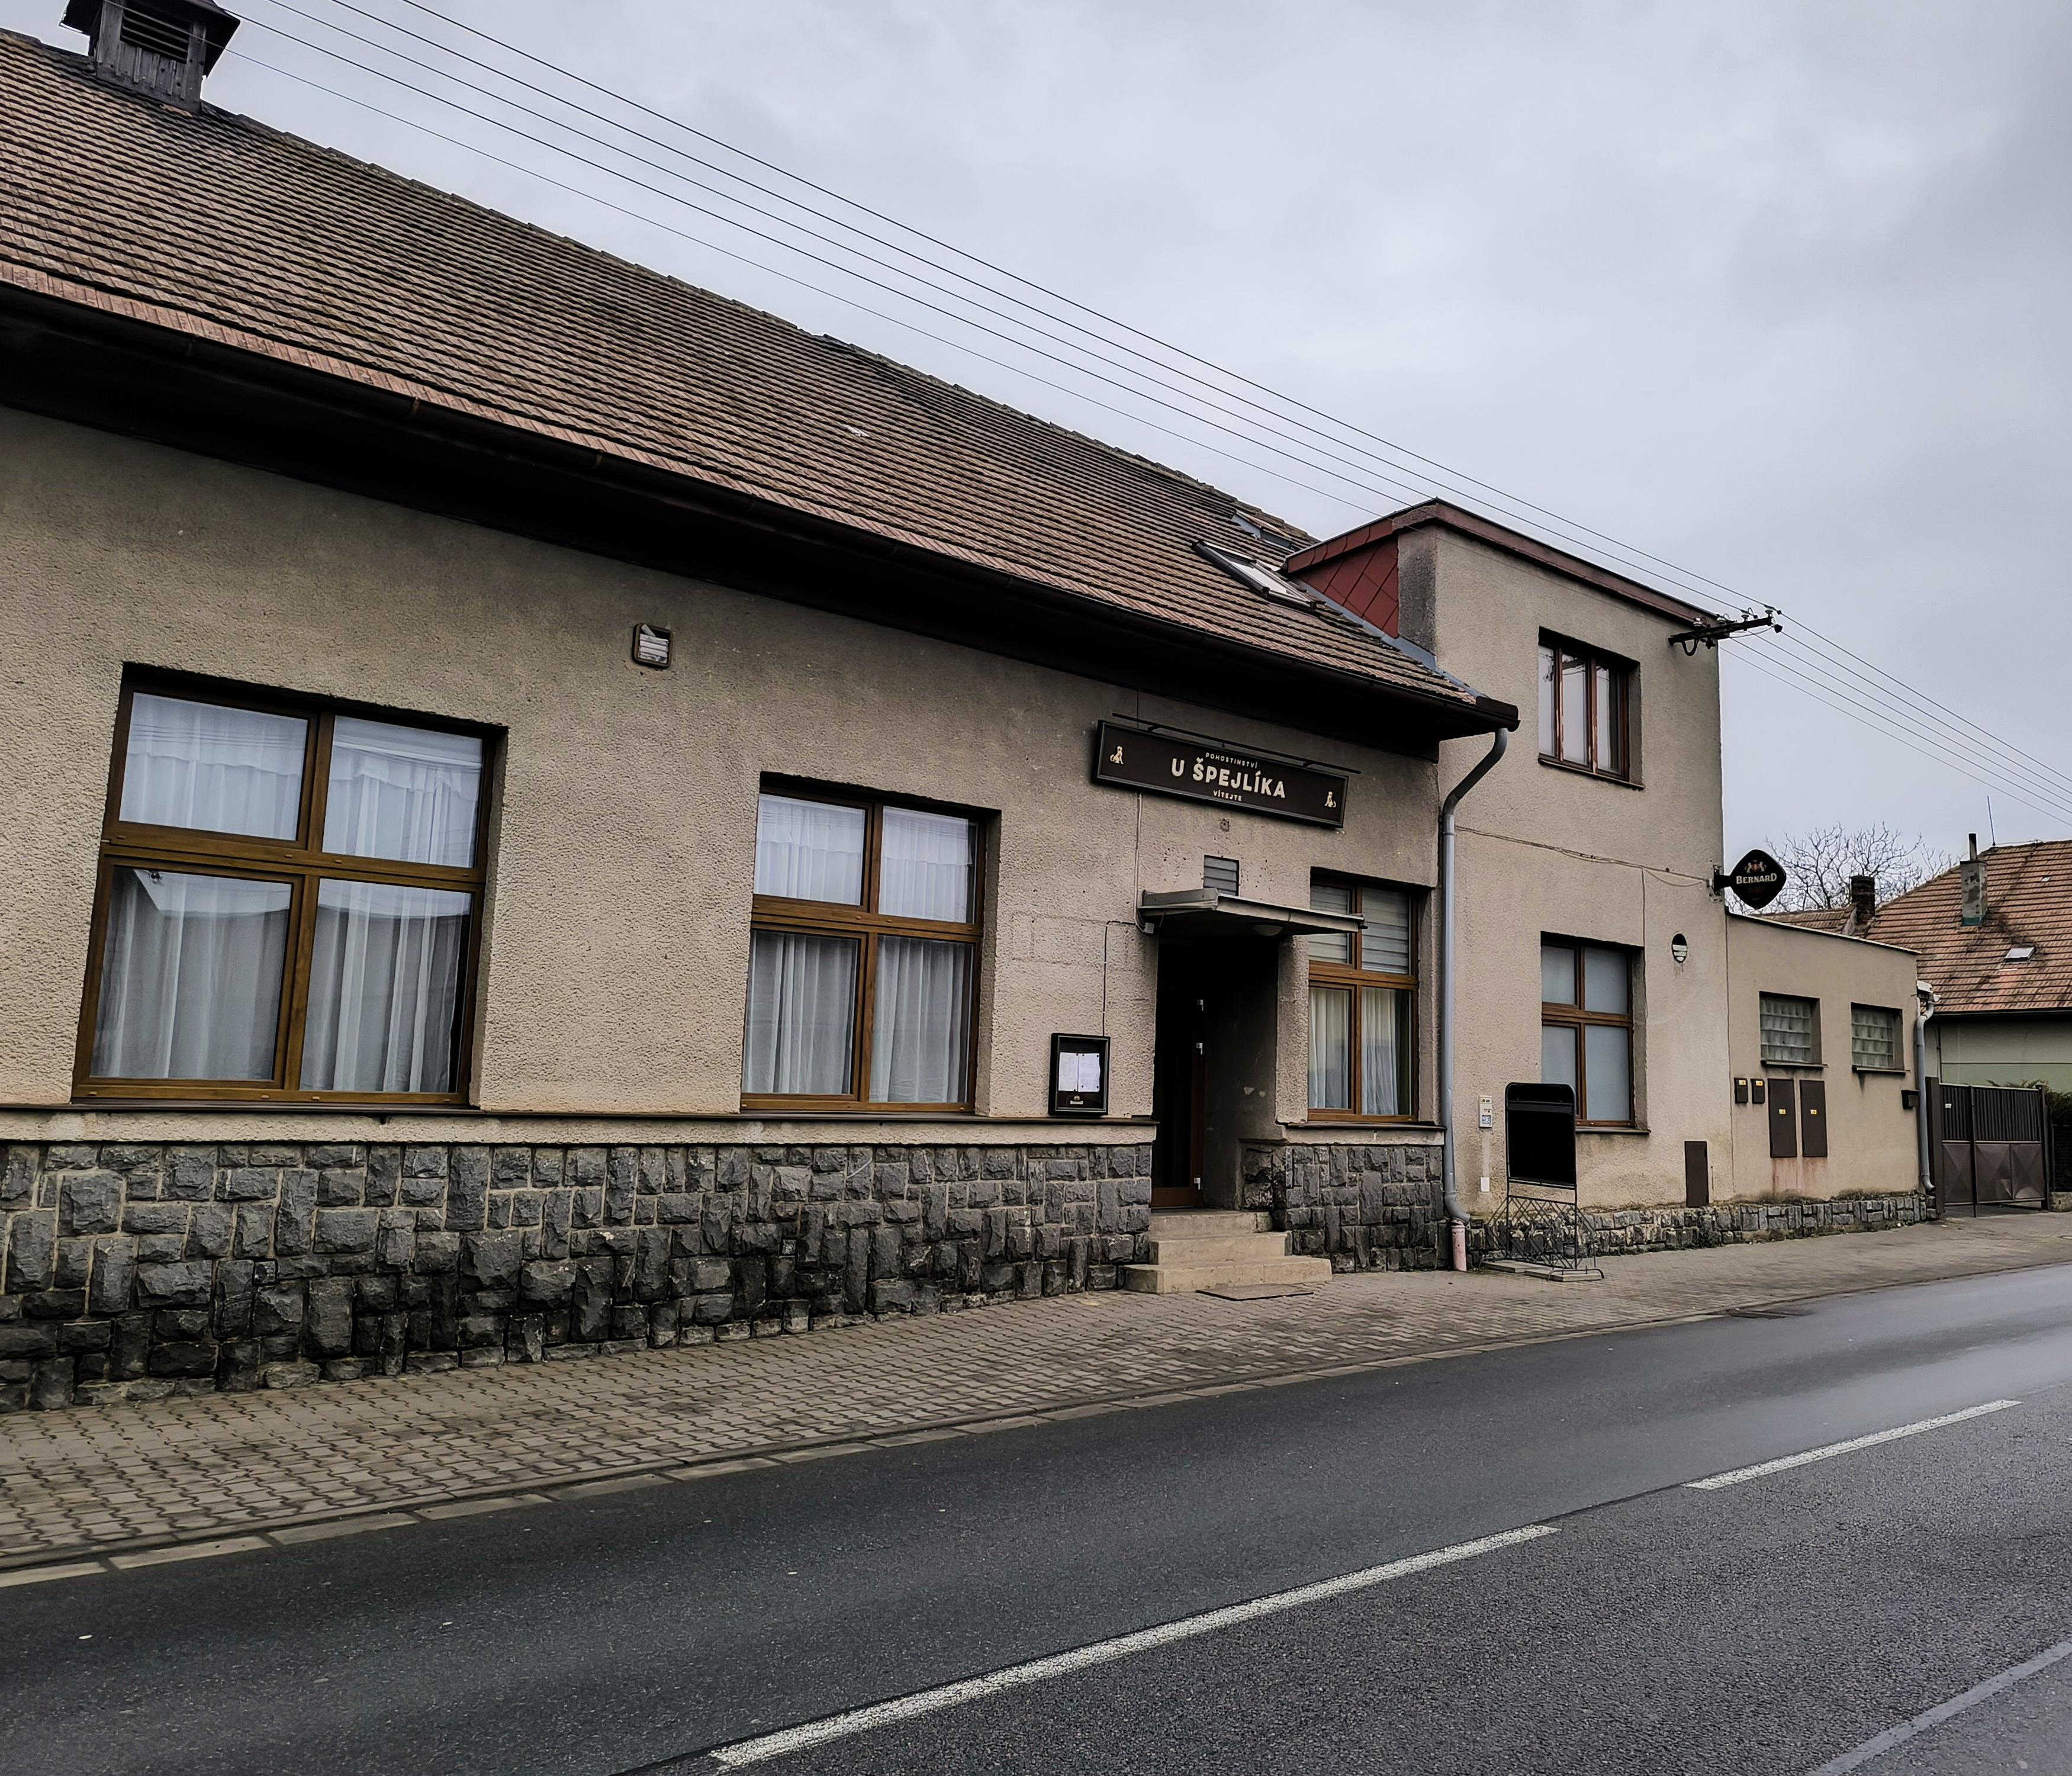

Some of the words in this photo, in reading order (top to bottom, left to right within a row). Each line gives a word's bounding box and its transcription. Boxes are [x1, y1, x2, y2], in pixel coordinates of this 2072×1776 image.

[1205, 752, 1258, 768] POHOSTINSTVÍ
[1172, 758, 1185, 777] U
[1192, 757, 1285, 798] ŠPEJLÍKA
[1213, 790, 1242, 802] VÍTEJTE
[1736, 873, 1777, 884] BERNARD
